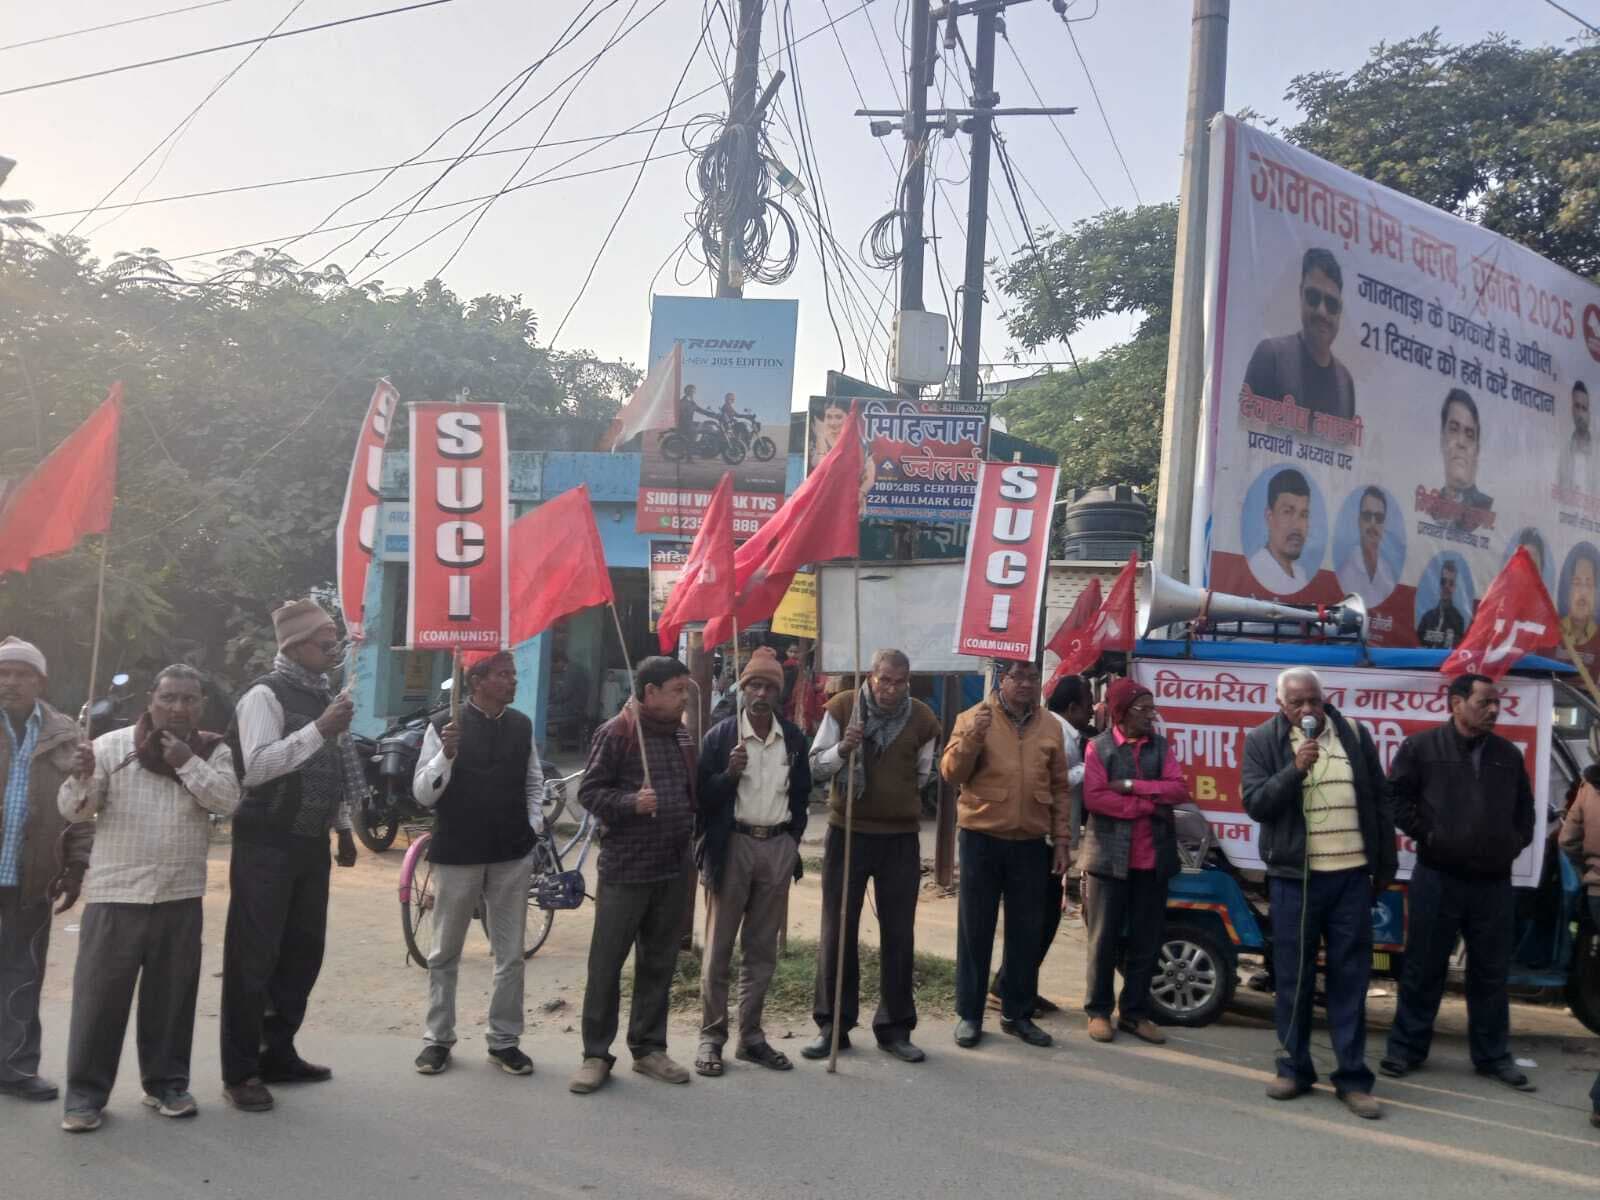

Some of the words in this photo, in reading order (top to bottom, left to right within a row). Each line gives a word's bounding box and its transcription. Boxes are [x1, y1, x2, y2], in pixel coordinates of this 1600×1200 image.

[1248, 152, 1360, 250] जामताड़ा
[1366, 189, 1405, 264] प्रेस
[1527, 283, 1575, 340] 2025
[1357, 273, 1424, 325] जामताड़ा
[1427, 296, 1444, 329] के
[1498, 327, 1511, 361] से
[687, 338, 756, 351] RONIN
[711, 357, 734, 367] 2025
[736, 358, 784, 369] EDITION
[1360, 322, 1380, 352] 21
[1384, 322, 1434, 370] दिसंबर
[1437, 345, 1457, 379] को
[1511, 379, 1555, 417] मतदान
[862, 400, 986, 447] मिहिजाम
[900, 446, 984, 482] ज्वेलर्स
[1248, 430, 1294, 457] प्रत्याशी
[1296, 443, 1335, 467] अध्यक्ष
[1337, 453, 1354, 472] पद
[436, 411, 485, 622] SUCI
[646, 491, 692, 507] SIDDHI
[751, 496, 777, 511] TVS
[867, 495, 888, 505] 22K
[891, 496, 950, 507] HALLMARK
[953, 498, 975, 508] GOL
[985, 466, 1039, 632] SUCI
[419, 630, 499, 643] (COMMUNIST)
[962, 638, 1029, 654] (COMMUNIST)
[1153, 669, 1269, 705] विकसित
